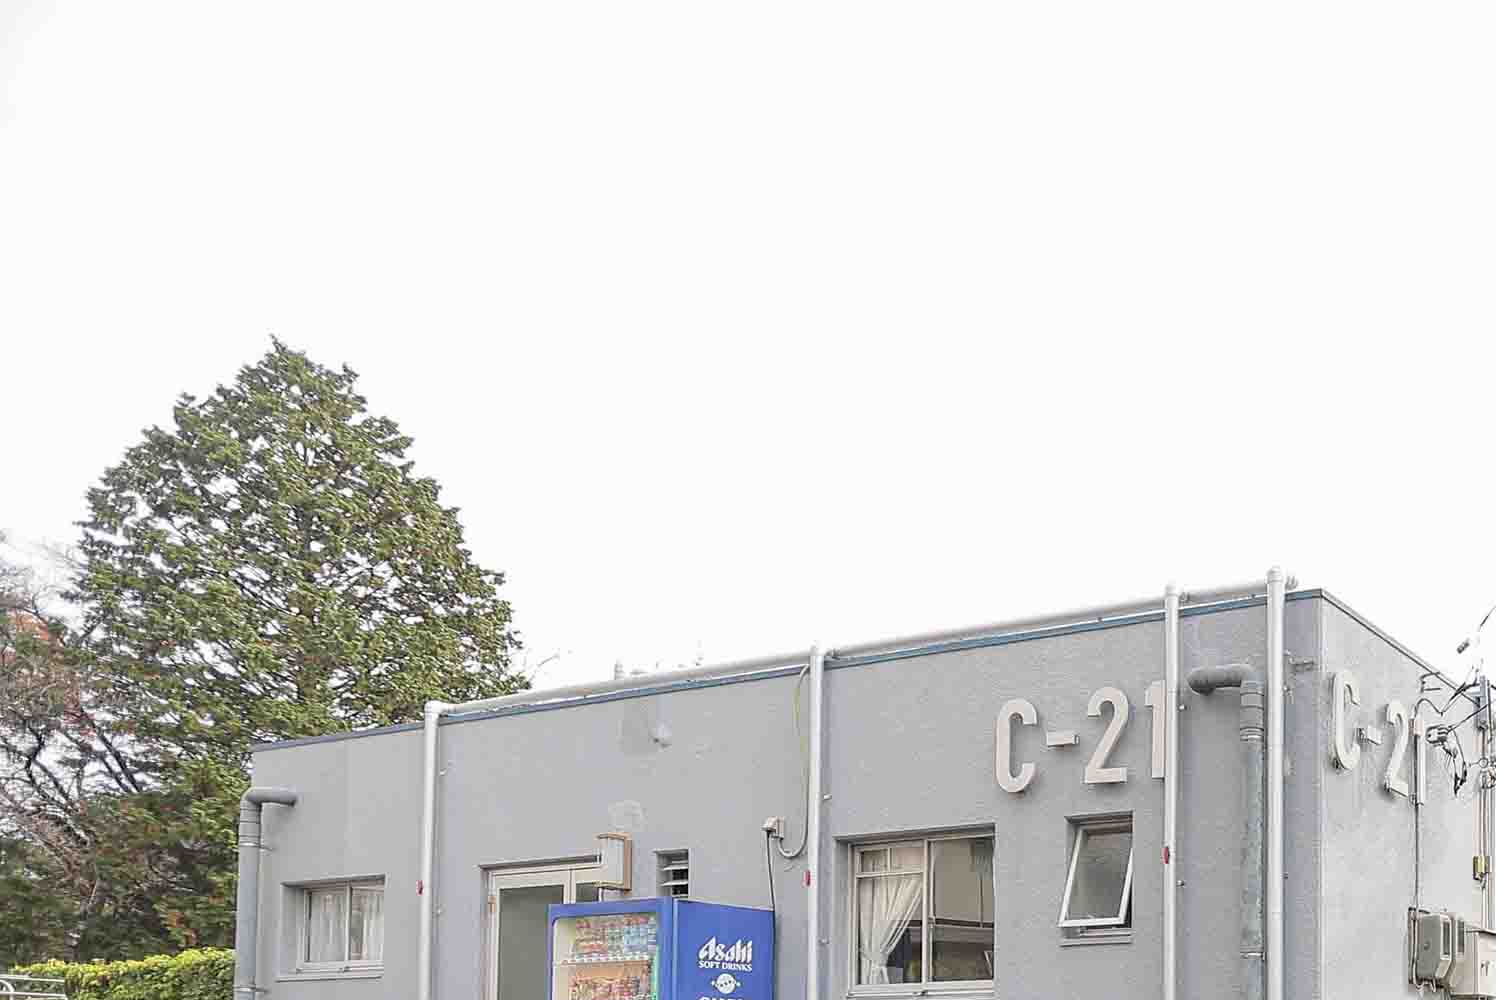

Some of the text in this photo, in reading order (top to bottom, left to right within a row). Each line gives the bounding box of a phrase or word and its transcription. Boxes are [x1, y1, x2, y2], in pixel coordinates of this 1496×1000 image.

[993, 679, 1167, 793] C-21
[698, 936, 752, 963] Asahi
[698, 960, 752, 972] SOFT DRINKS
